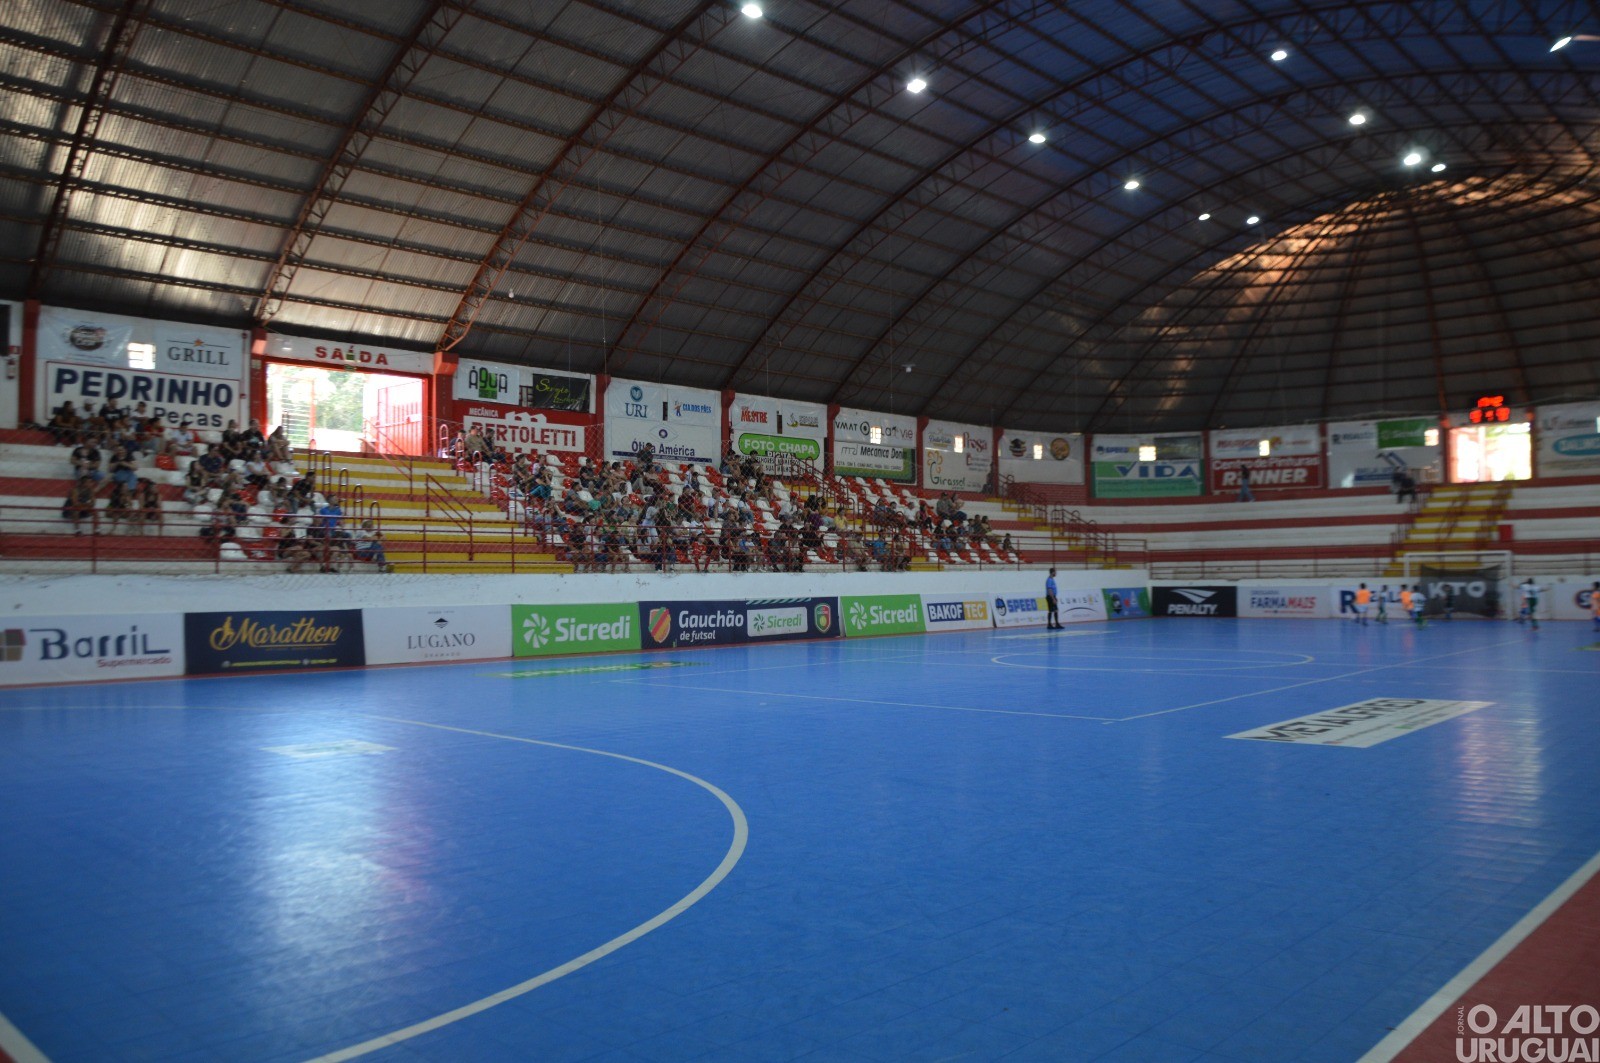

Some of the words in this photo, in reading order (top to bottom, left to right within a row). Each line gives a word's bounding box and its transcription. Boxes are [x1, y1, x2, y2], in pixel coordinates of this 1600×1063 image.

[168, 346, 230, 366] GRILL
[54, 367, 233, 408] PEDRINHO
[469, 407, 498, 418] MECÂNICA
[625, 402, 648, 418] URI
[741, 410, 768, 423] MESTRE
[631, 439, 656, 452] Ótia
[659, 443, 695, 456] América
[744, 440, 775, 450] FOTO
[779, 443, 816, 454] CHAPA
[1116, 461, 1200, 480] VIDA
[1222, 468, 1308, 486] RNNER
[1428, 580, 1486, 598] KTO
[928, 603, 963, 620] BAKOF
[965, 603, 984, 618] TEC
[1007, 598, 1037, 612] SPEED
[1167, 604, 1218, 614] PENALTY
[678, 610, 744, 628] Gauchão
[767, 614, 802, 628] Sicredi
[870, 604, 918, 625] Sicredi
[210, 616, 343, 650] Marathon
[555, 615, 631, 642] Sicredi
[680, 631, 690, 641] de
[691, 630, 716, 643] futsal
[408, 633, 475, 649] LUGANO
[97, 656, 172, 668] Supermercado
